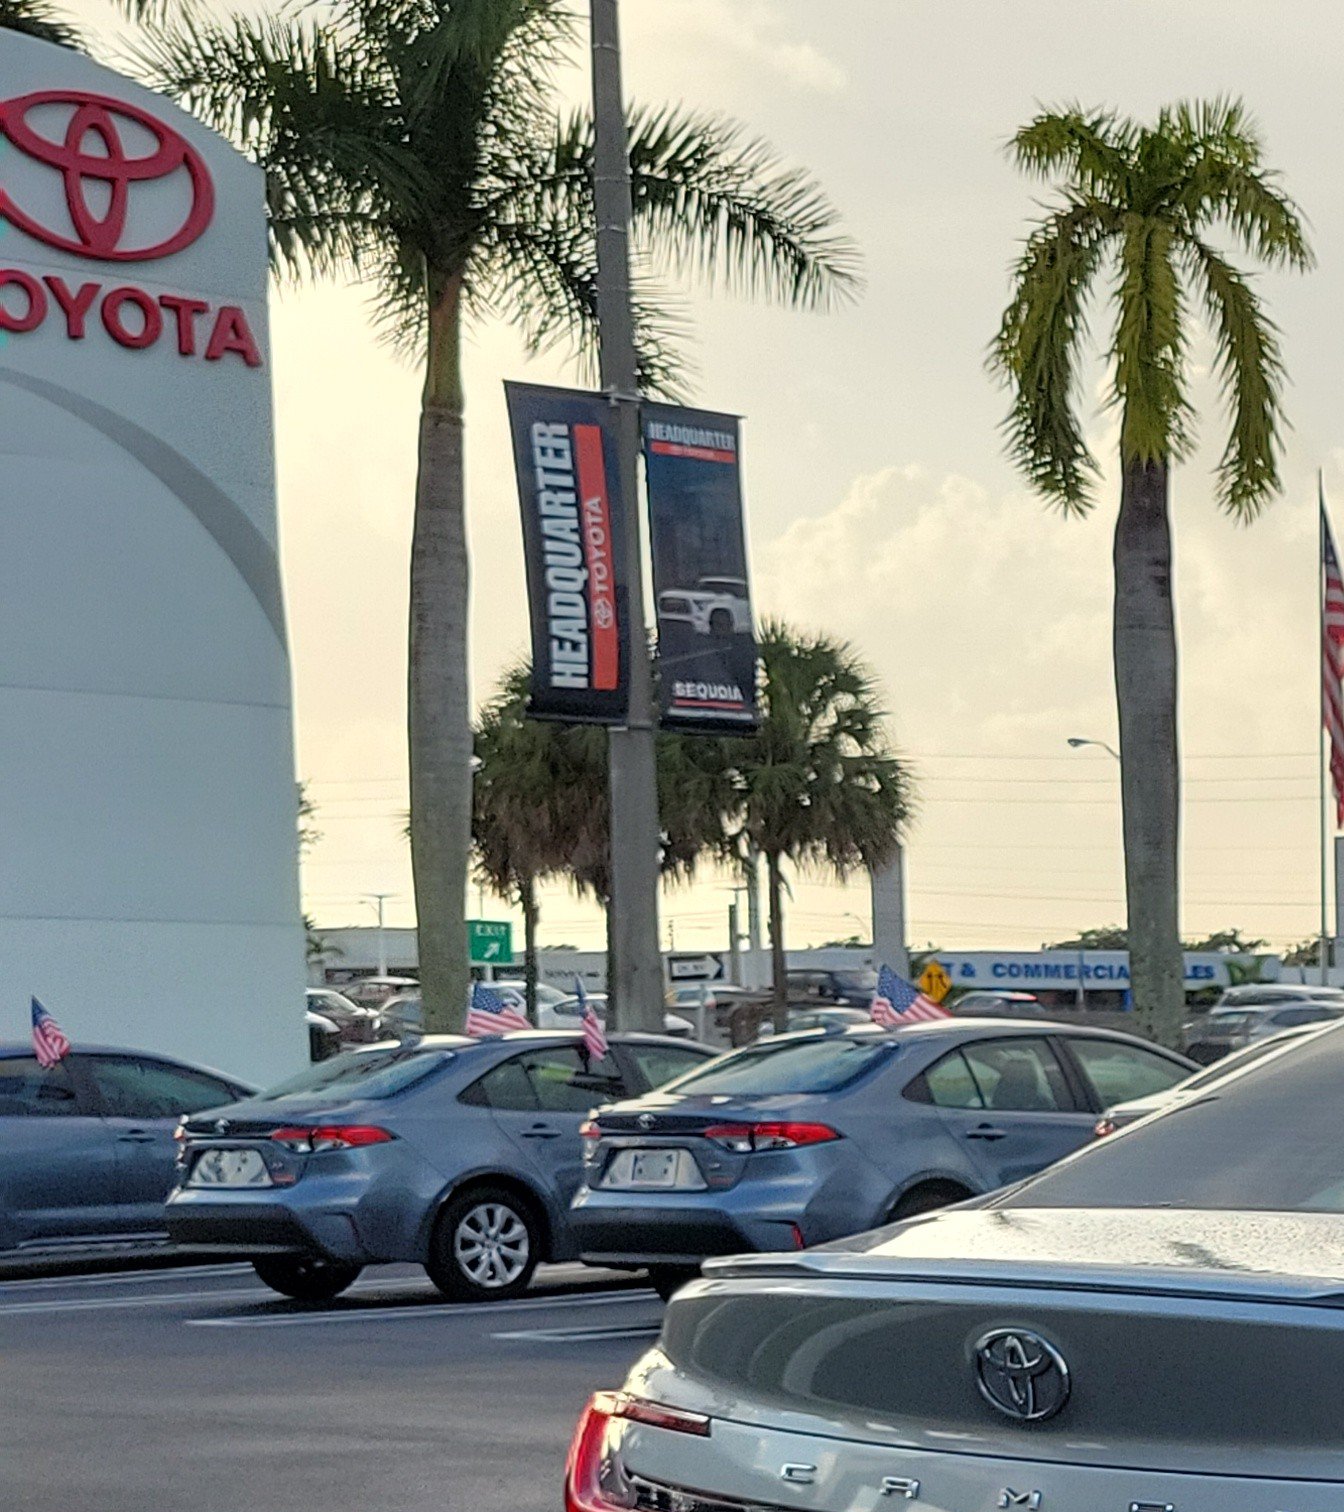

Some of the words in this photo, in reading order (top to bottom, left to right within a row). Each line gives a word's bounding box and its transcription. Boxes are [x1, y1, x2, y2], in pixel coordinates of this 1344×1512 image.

[648, 421, 736, 450] HEADQUARTER
[532, 421, 589, 689] HEADQUARTER
[584, 496, 608, 593] TOYOTA
[673, 681, 743, 700] SEQUOIA
[992, 962, 1130, 979] COMMERCIA
[1183, 964, 1215, 980] LES
